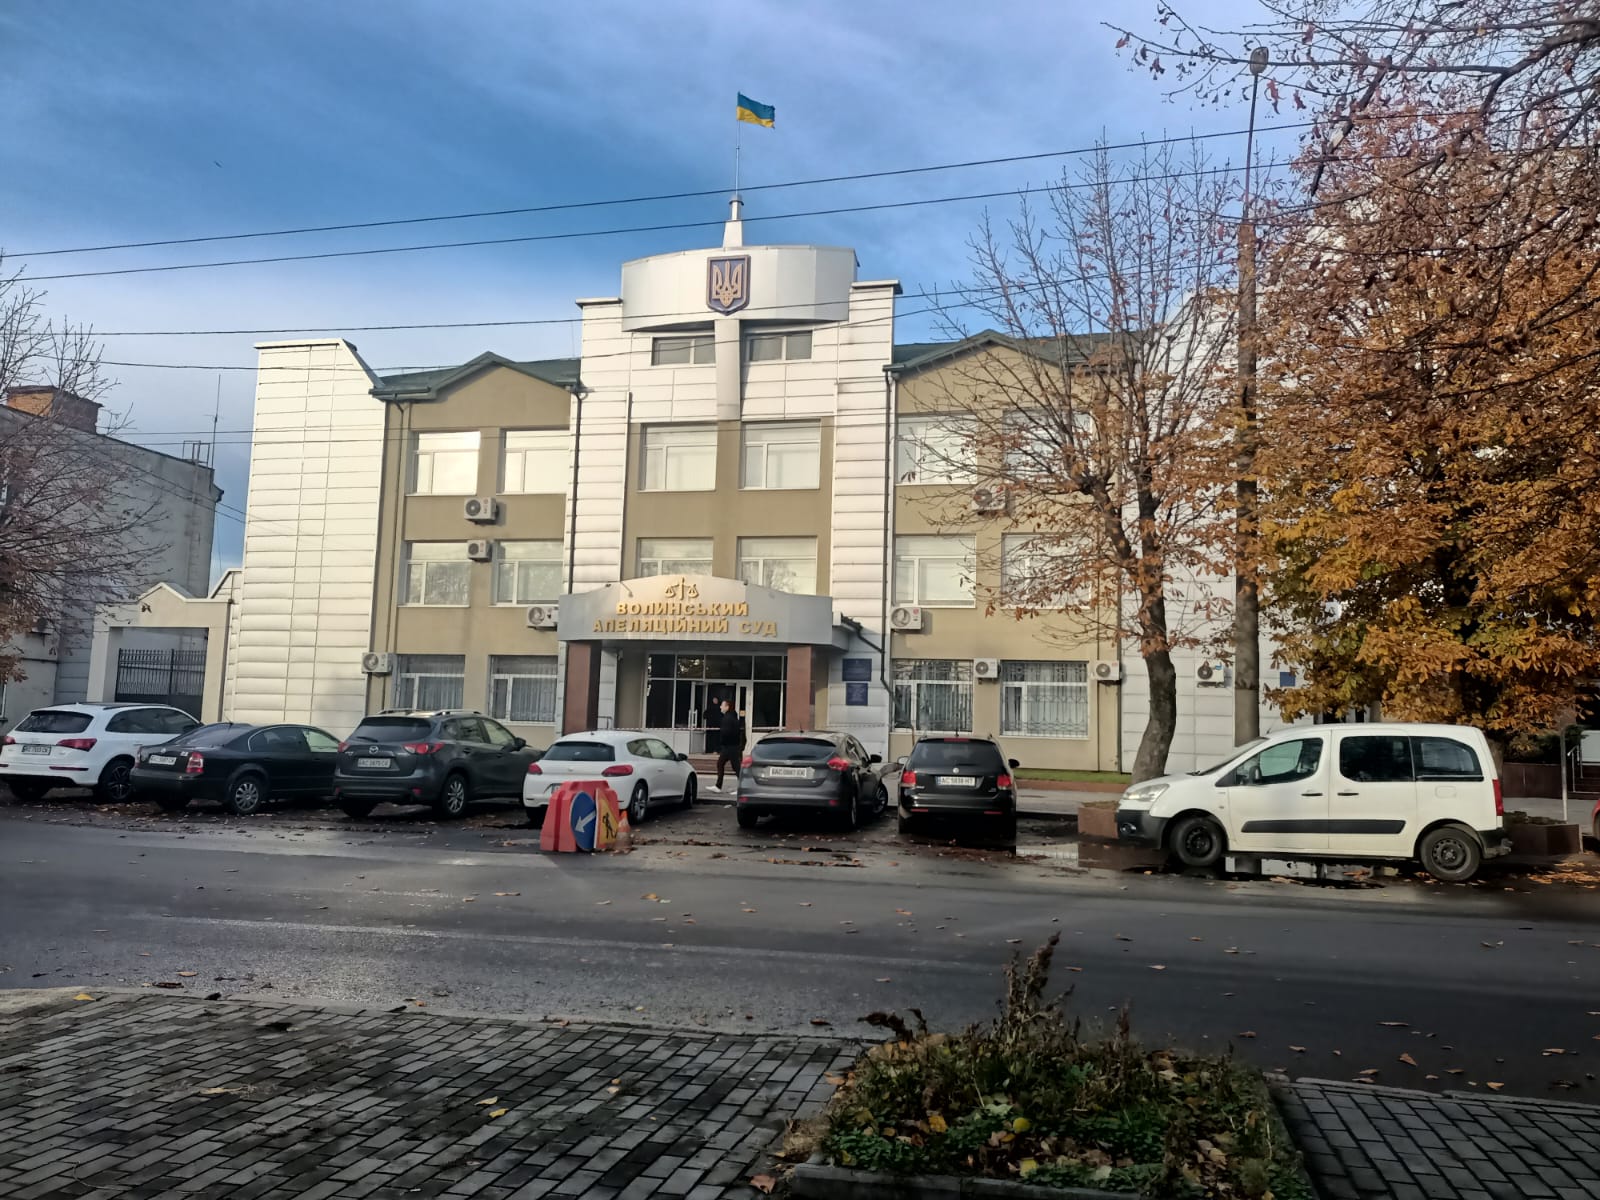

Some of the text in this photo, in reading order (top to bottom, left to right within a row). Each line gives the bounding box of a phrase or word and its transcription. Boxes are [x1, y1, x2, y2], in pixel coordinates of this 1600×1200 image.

[616, 601, 749, 616] ВОЛИНСЬКИЙ
[593, 617, 777, 637] АПЕЛЯЦІЙНИЙ СУД
